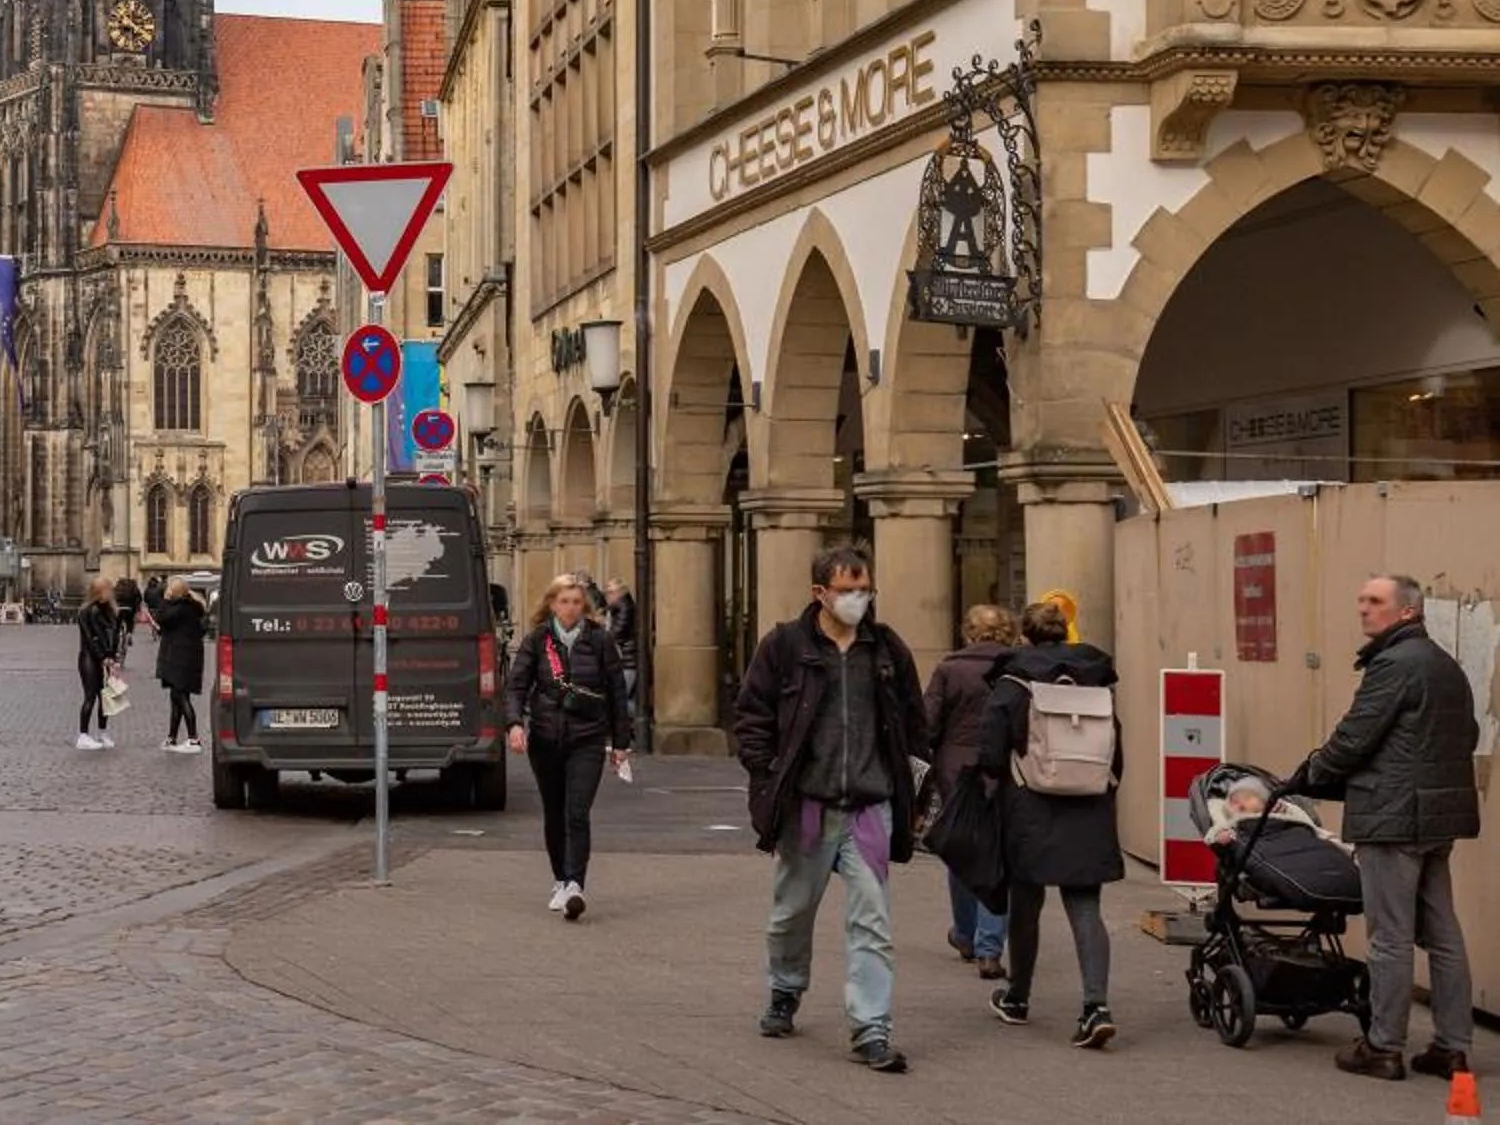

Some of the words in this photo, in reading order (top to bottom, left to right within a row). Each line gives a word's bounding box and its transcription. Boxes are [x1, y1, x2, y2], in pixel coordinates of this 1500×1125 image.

[708, 94, 815, 202] CHEESE
[840, 29, 937, 140] MORE
[263, 539, 331, 560] WWS
[252, 618, 291, 633] Tel.:
